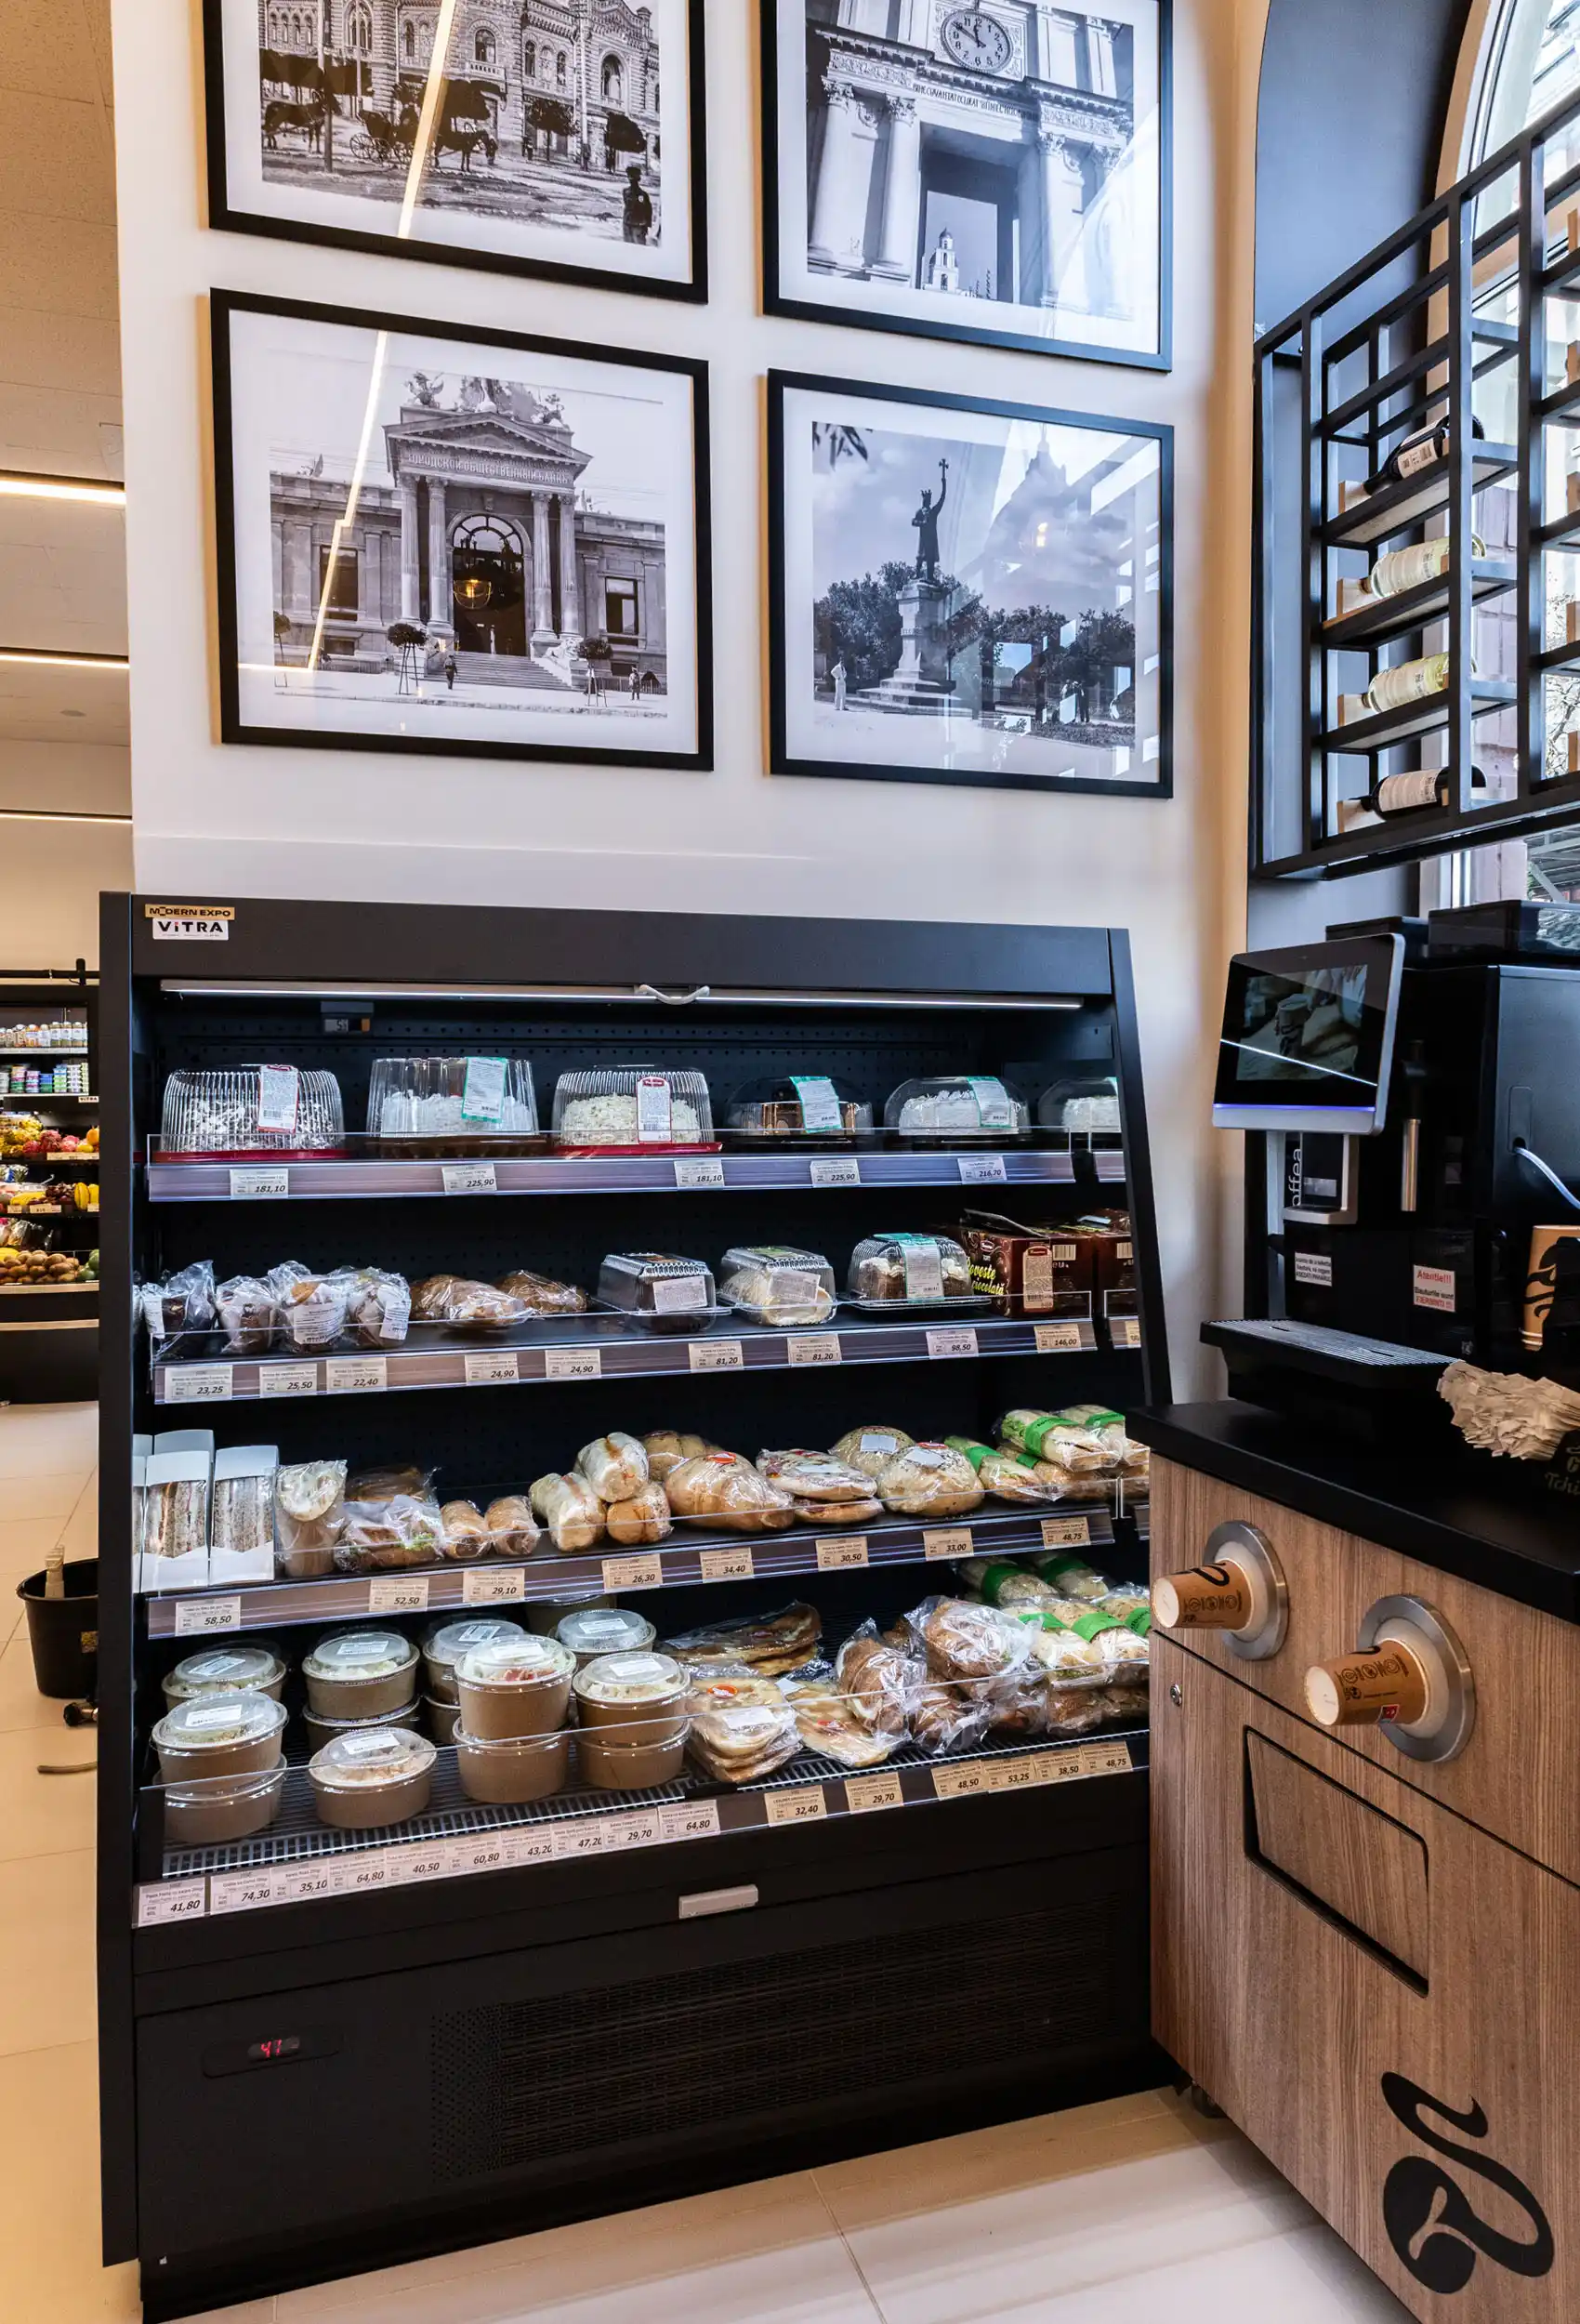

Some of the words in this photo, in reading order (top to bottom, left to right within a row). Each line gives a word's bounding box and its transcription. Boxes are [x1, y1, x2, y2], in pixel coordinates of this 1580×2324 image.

[149, 906, 198, 916] MODERN
[199, 909, 231, 918] EXPO
[466, 1178, 495, 1188] 225,90
[696, 1174, 722, 1183] 181,10
[830, 1173, 856, 1182] 225,90
[255, 1185, 286, 1194] 181,10
[951, 1343, 972, 1353] 98,50
[716, 1356, 738, 1367] 81,20
[812, 1353, 834, 1362] 81,20
[491, 1369, 514, 1379] 24,90
[570, 1366, 594, 1375] 24,90
[286, 1380, 313, 1391] 25,50
[353, 1378, 378, 1388] 22,40
[197, 1385, 223, 1395] 23,25
[1062, 1532, 1082, 1541] 48,75
[946, 1543, 967, 1552] 33,00
[840, 1552, 862, 1563] 30,50
[723, 1565, 745, 1575] 34,40
[632, 1573, 655, 1584] 26,30
[492, 1586, 517, 1595] 29,10
[394, 1597, 419, 1605] 52,50
[204, 1615, 231, 1626] 58,50
[1106, 1757, 1127, 1767] 48,75
[1058, 1765, 1079, 1776] 38,50
[957, 1777, 980, 1789] 48,50
[1007, 1773, 1030, 1783] 53,25
[873, 1792, 895, 1804] 29,70
[795, 1804, 818, 1816] 32,40
[686, 1819, 710, 1830] 64,80
[626, 1829, 652, 1841] 29,70
[578, 1837, 602, 1848] 47,20
[527, 1843, 552, 1856] 43,20
[473, 1852, 500, 1865] 60,80
[413, 1862, 441, 1874] 40,50
[356, 1870, 385, 1883] 64,80
[299, 1879, 327, 1893] 35,10
[242, 1889, 270, 1902] 74,30
[170, 1899, 201, 1913] 41,80
